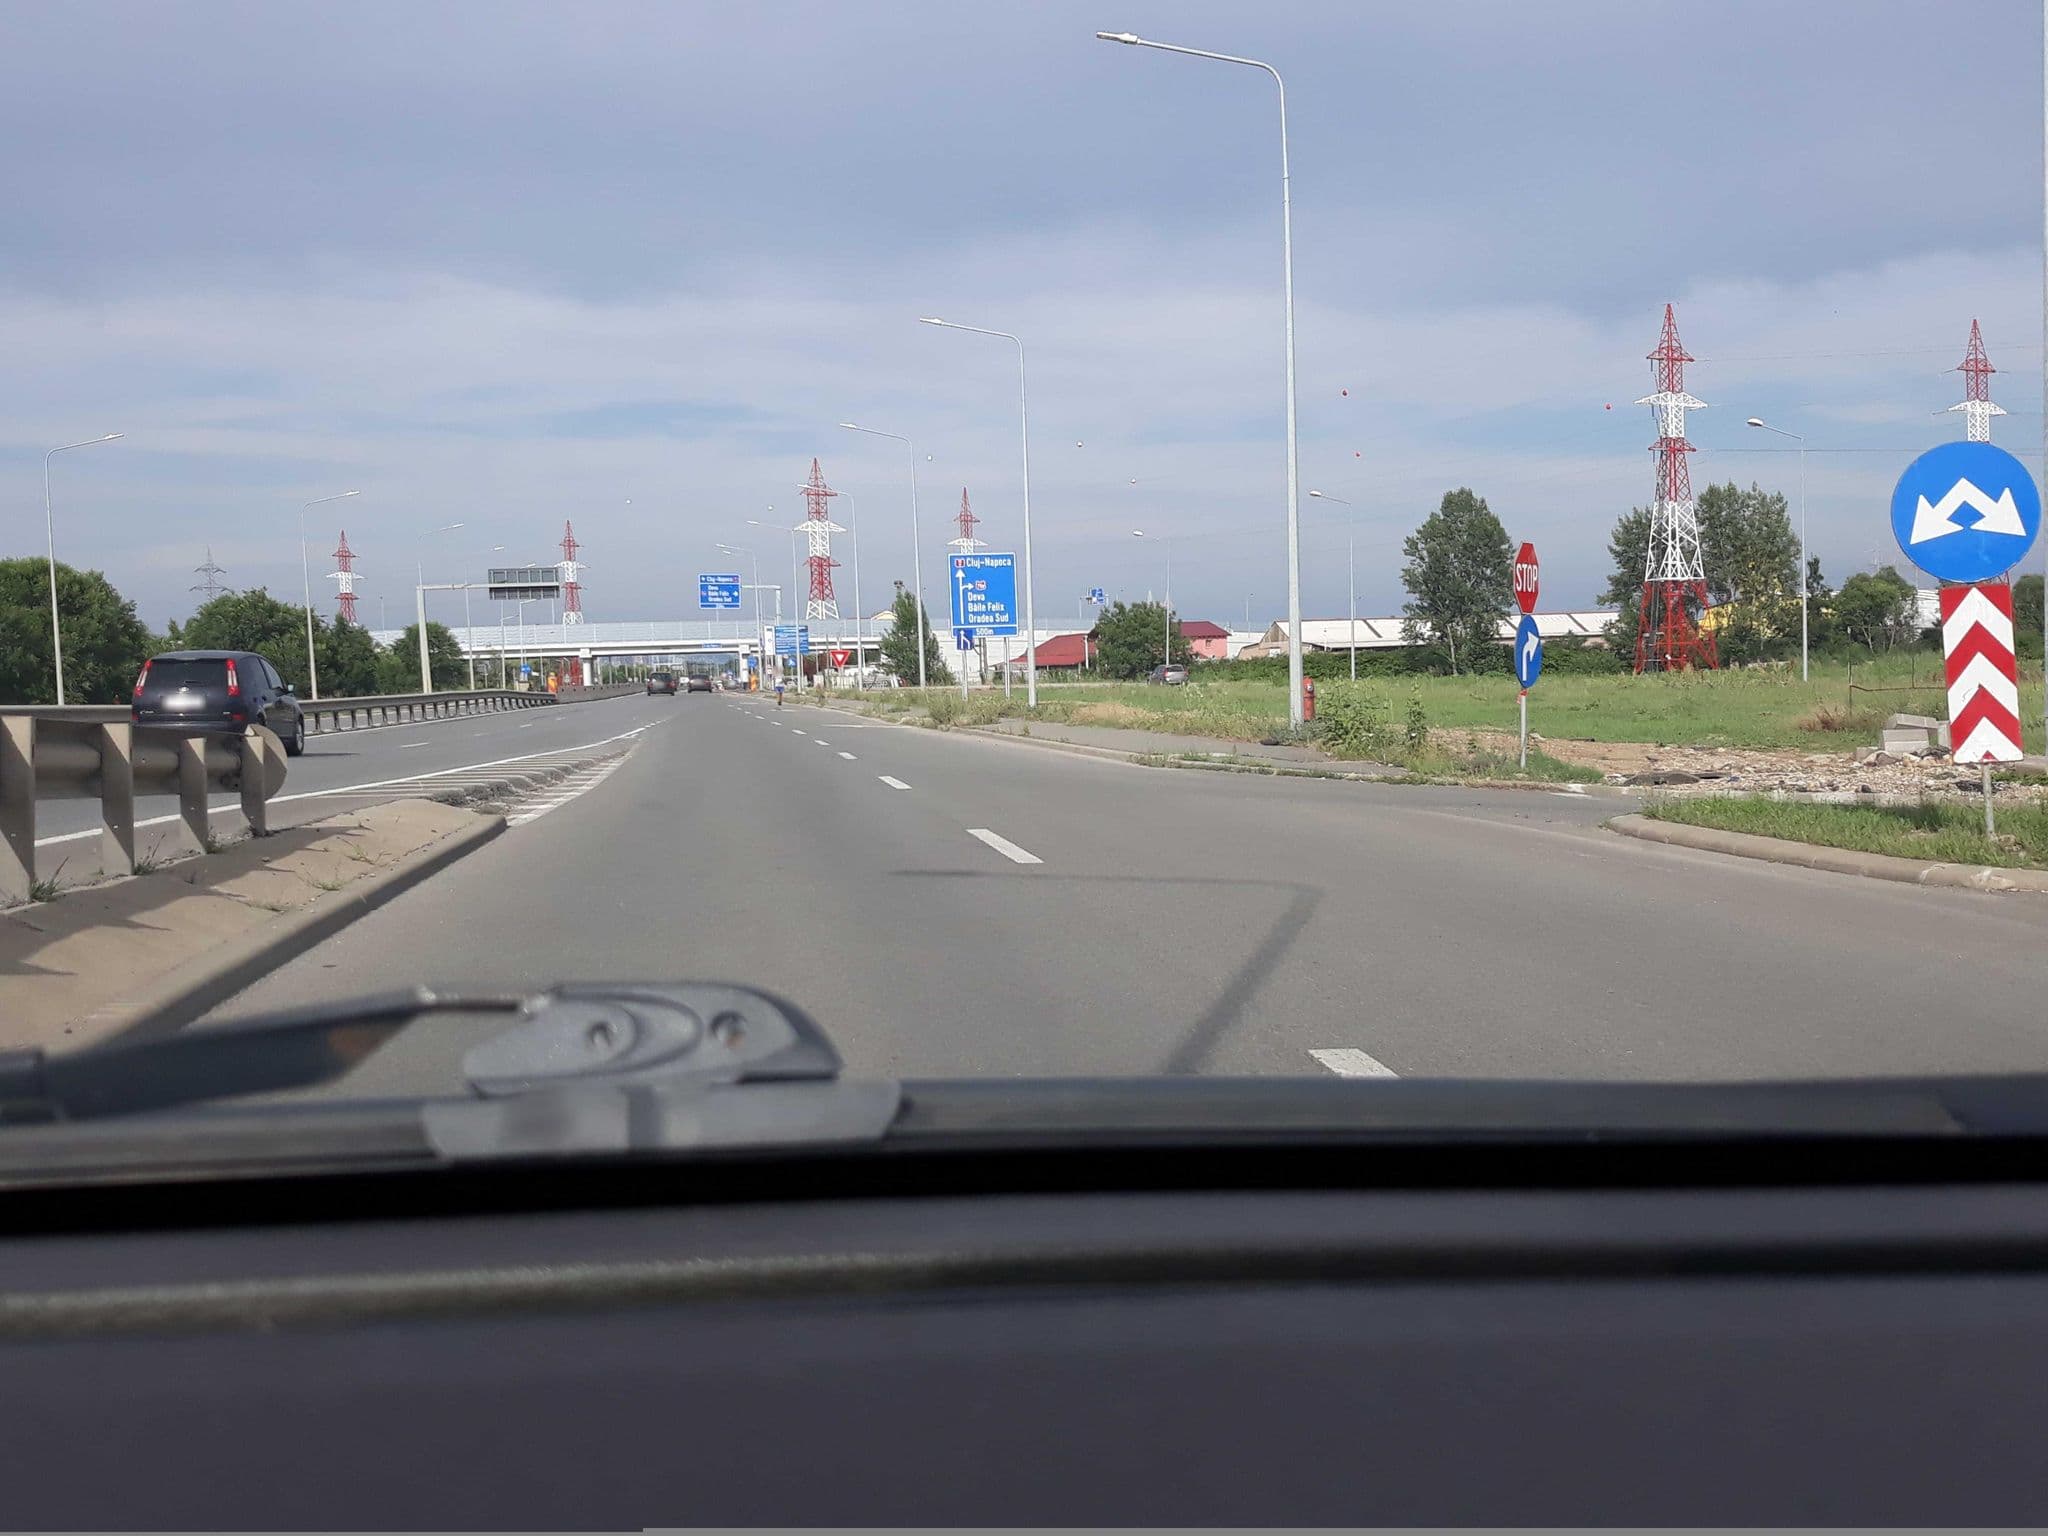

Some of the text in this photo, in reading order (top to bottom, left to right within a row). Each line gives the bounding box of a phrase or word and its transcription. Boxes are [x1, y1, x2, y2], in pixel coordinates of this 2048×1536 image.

[967, 557, 1012, 569] Cluj-Napoca
[1516, 563, 1538, 593] STOP
[967, 592, 986, 601] Deva
[987, 602, 1005, 612] Felix
[968, 612, 1009, 623] Oradea Sud
[976, 628, 994, 636] 500m
